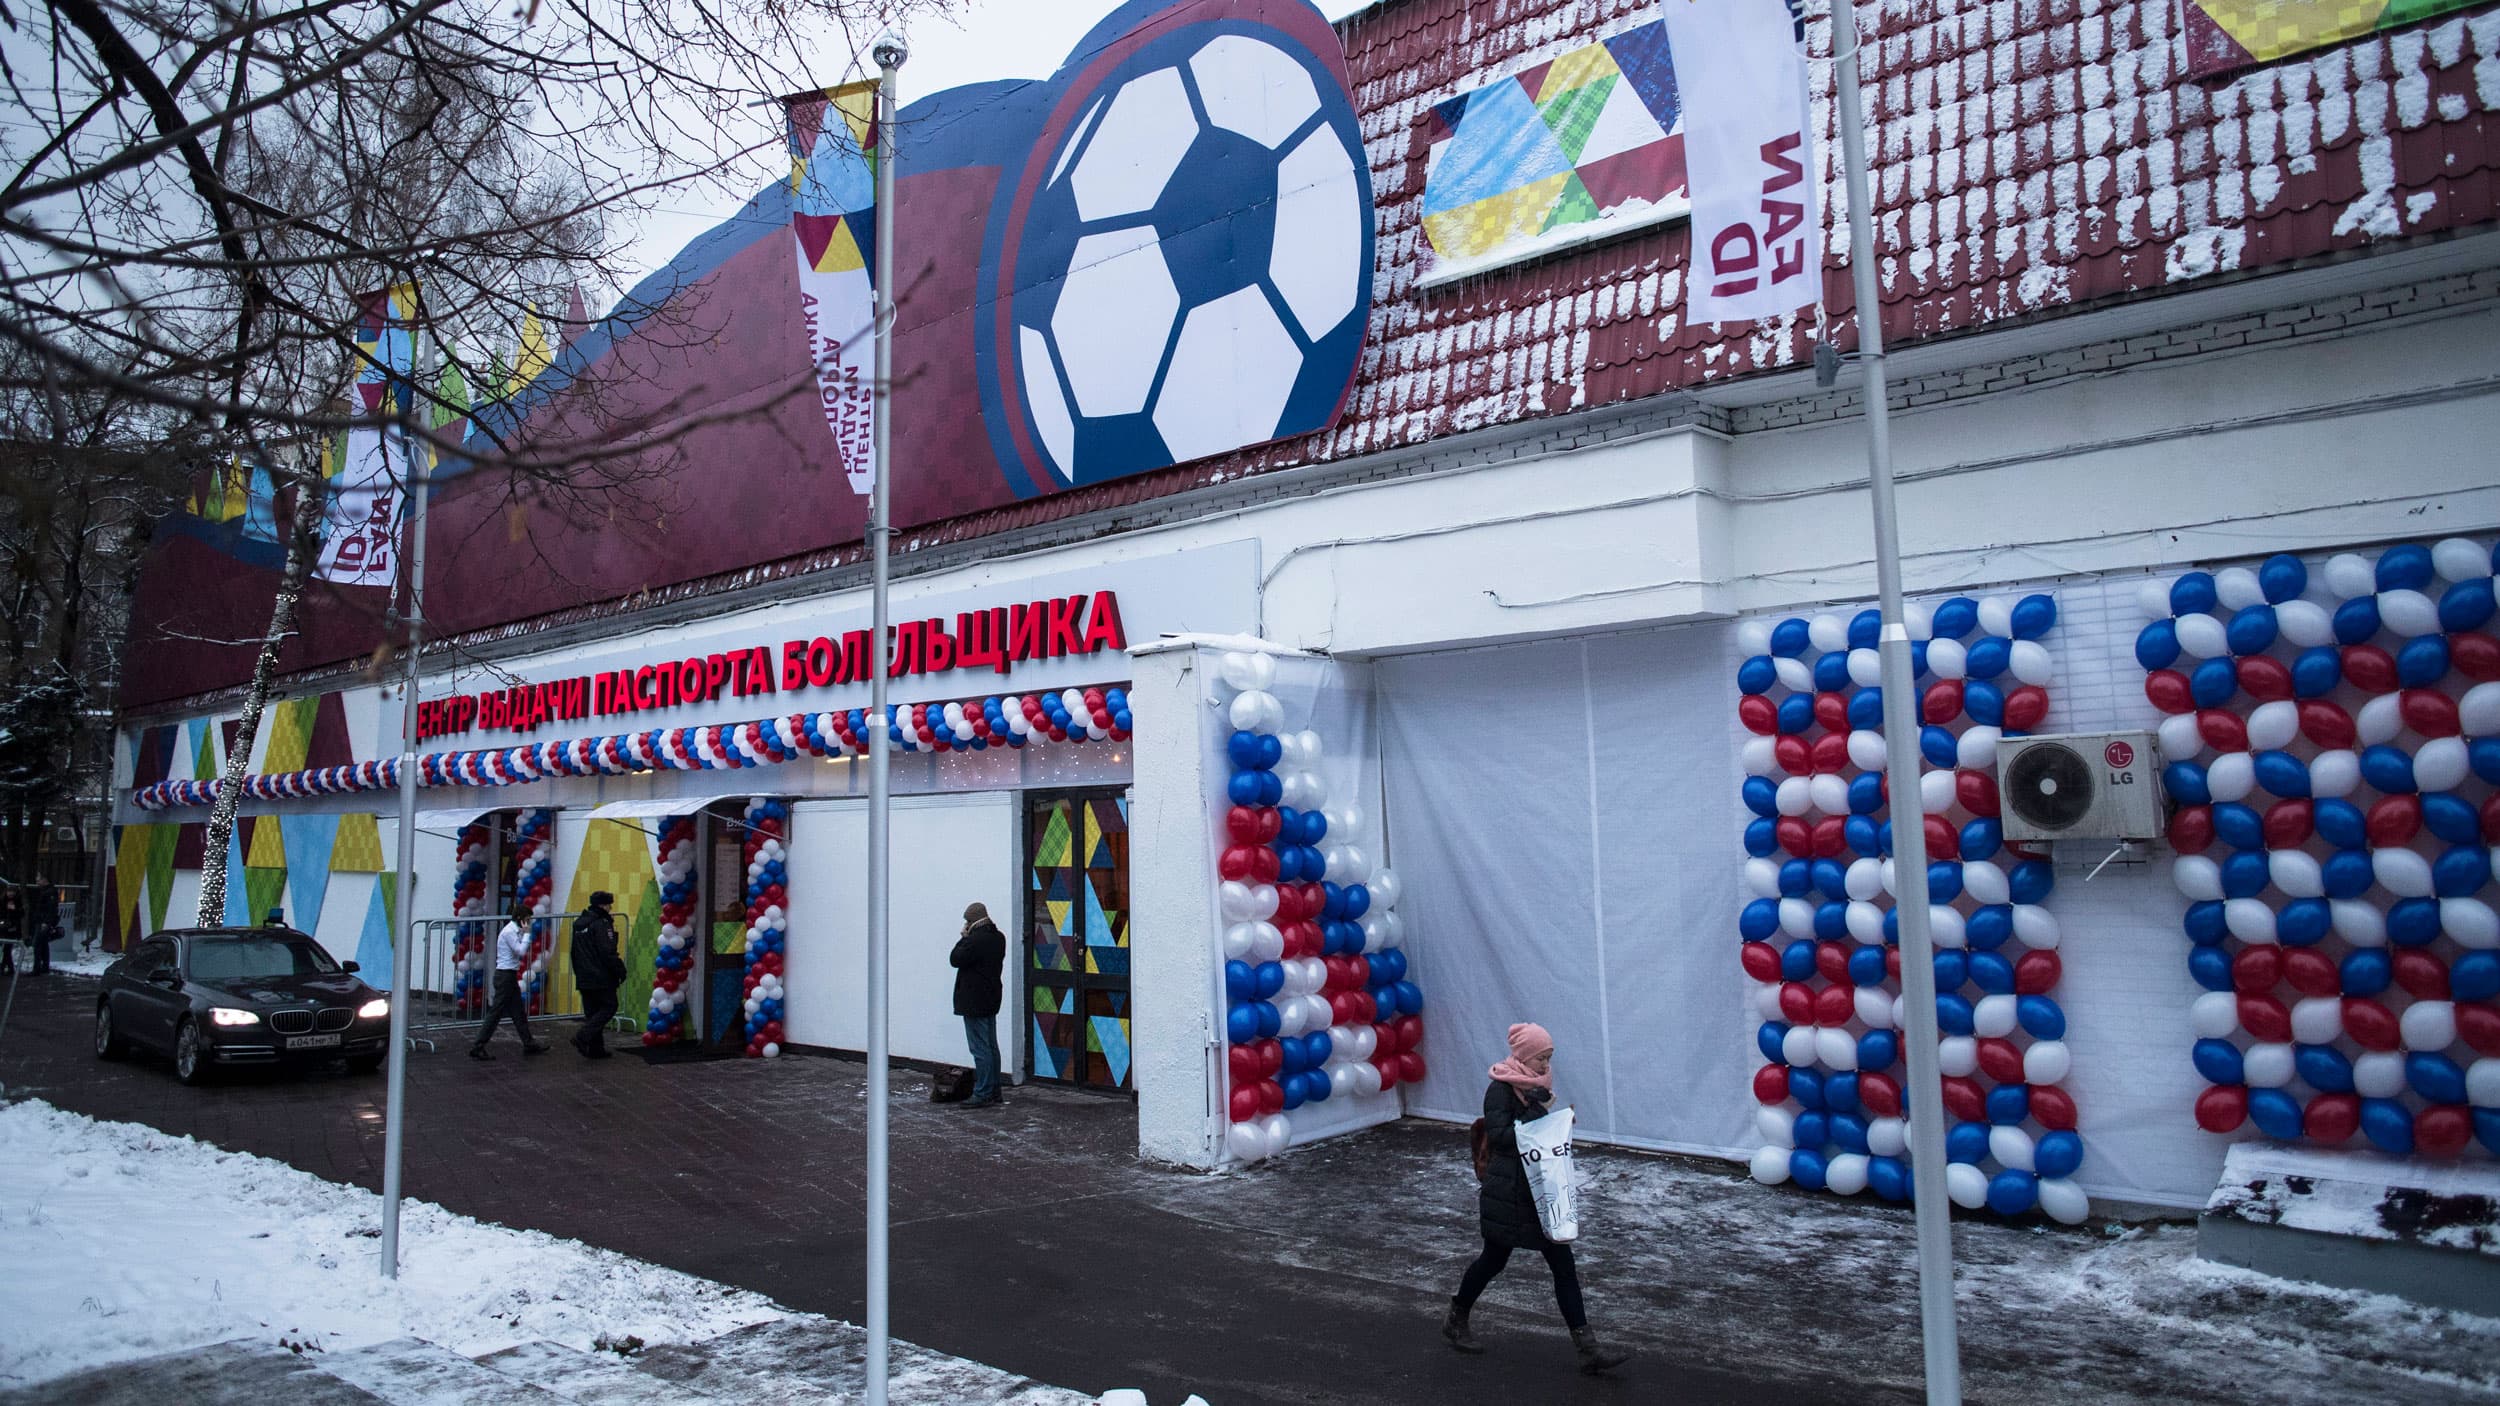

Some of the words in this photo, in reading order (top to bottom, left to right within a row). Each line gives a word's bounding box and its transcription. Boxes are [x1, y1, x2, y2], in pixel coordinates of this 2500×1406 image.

[403, 695, 478, 745] ЕНТР
[478, 676, 590, 733] ВЫДАЧИ
[594, 646, 776, 716] ПАСПОРТА
[2110, 772, 2133, 785] LG
